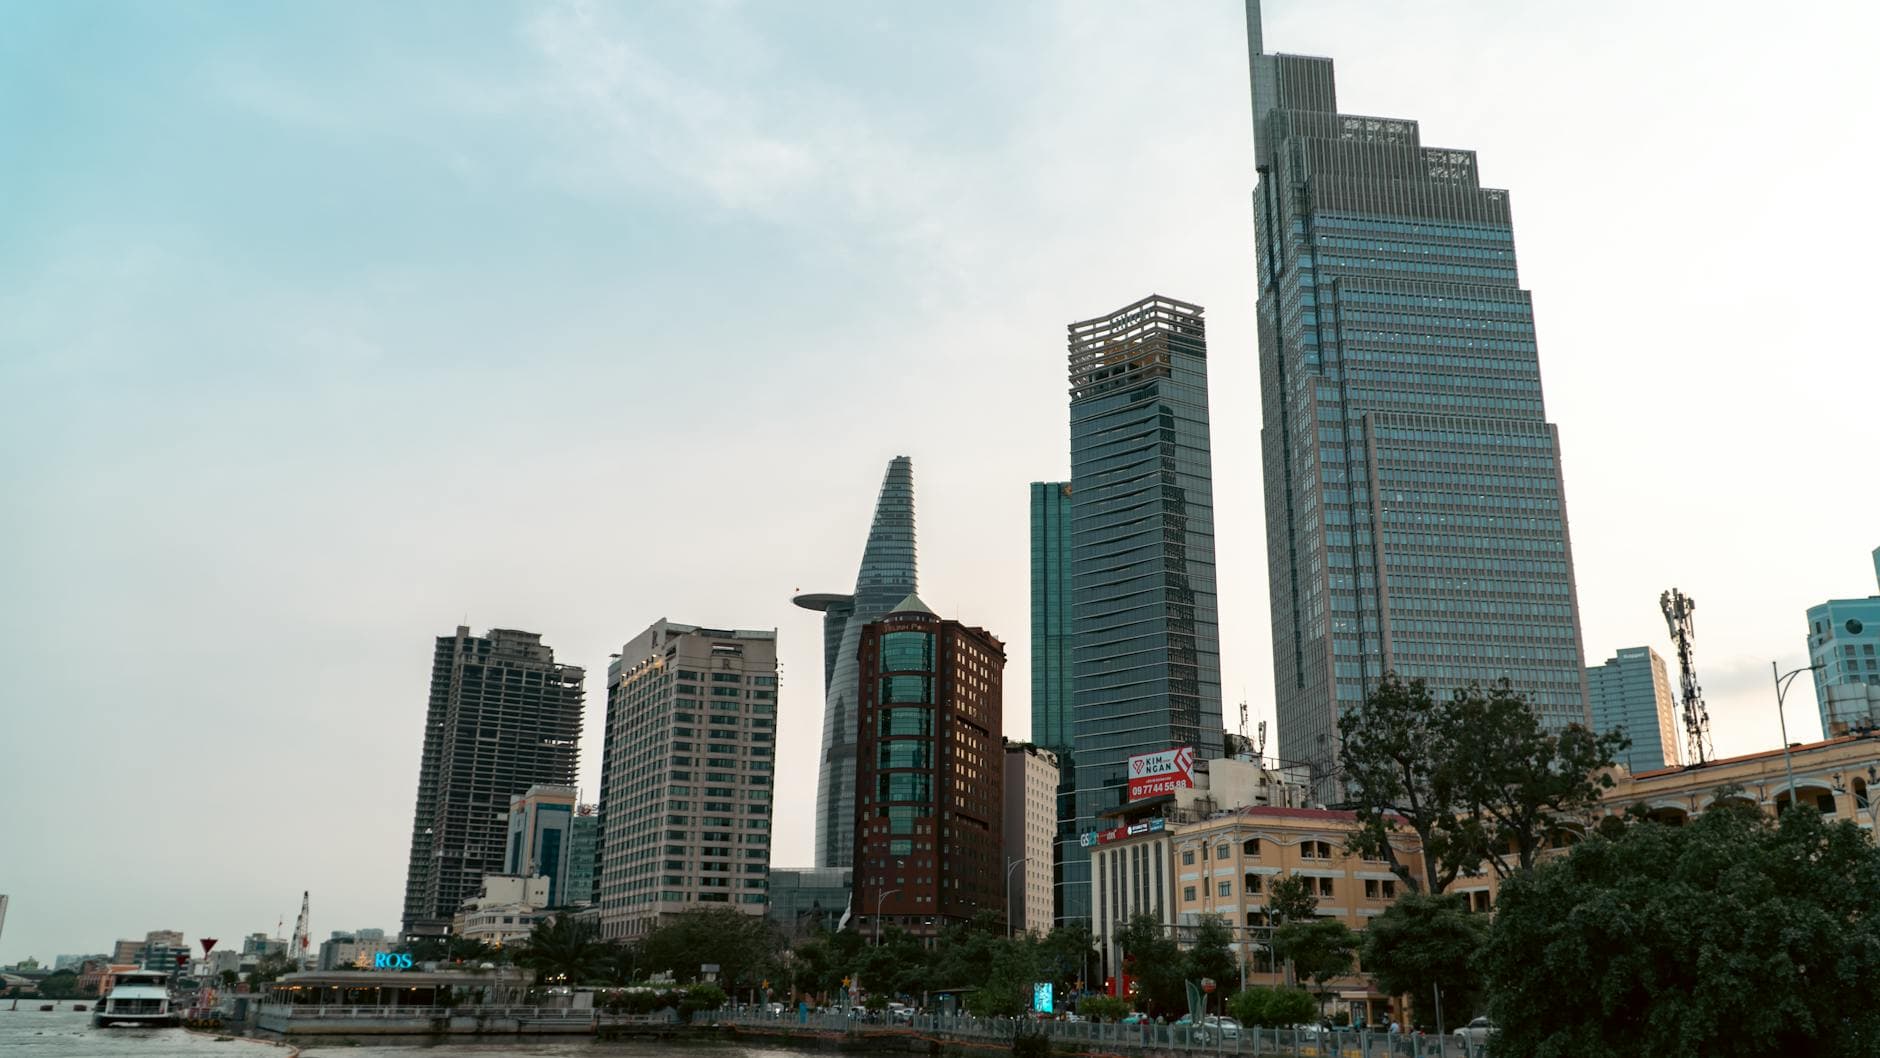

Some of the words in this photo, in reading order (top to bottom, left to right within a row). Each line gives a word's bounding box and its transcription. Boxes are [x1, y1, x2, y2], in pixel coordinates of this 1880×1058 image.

[1146, 756, 1162, 765] KIM
[1146, 763, 1171, 774] NGAN
[375, 952, 412, 968] ROS
